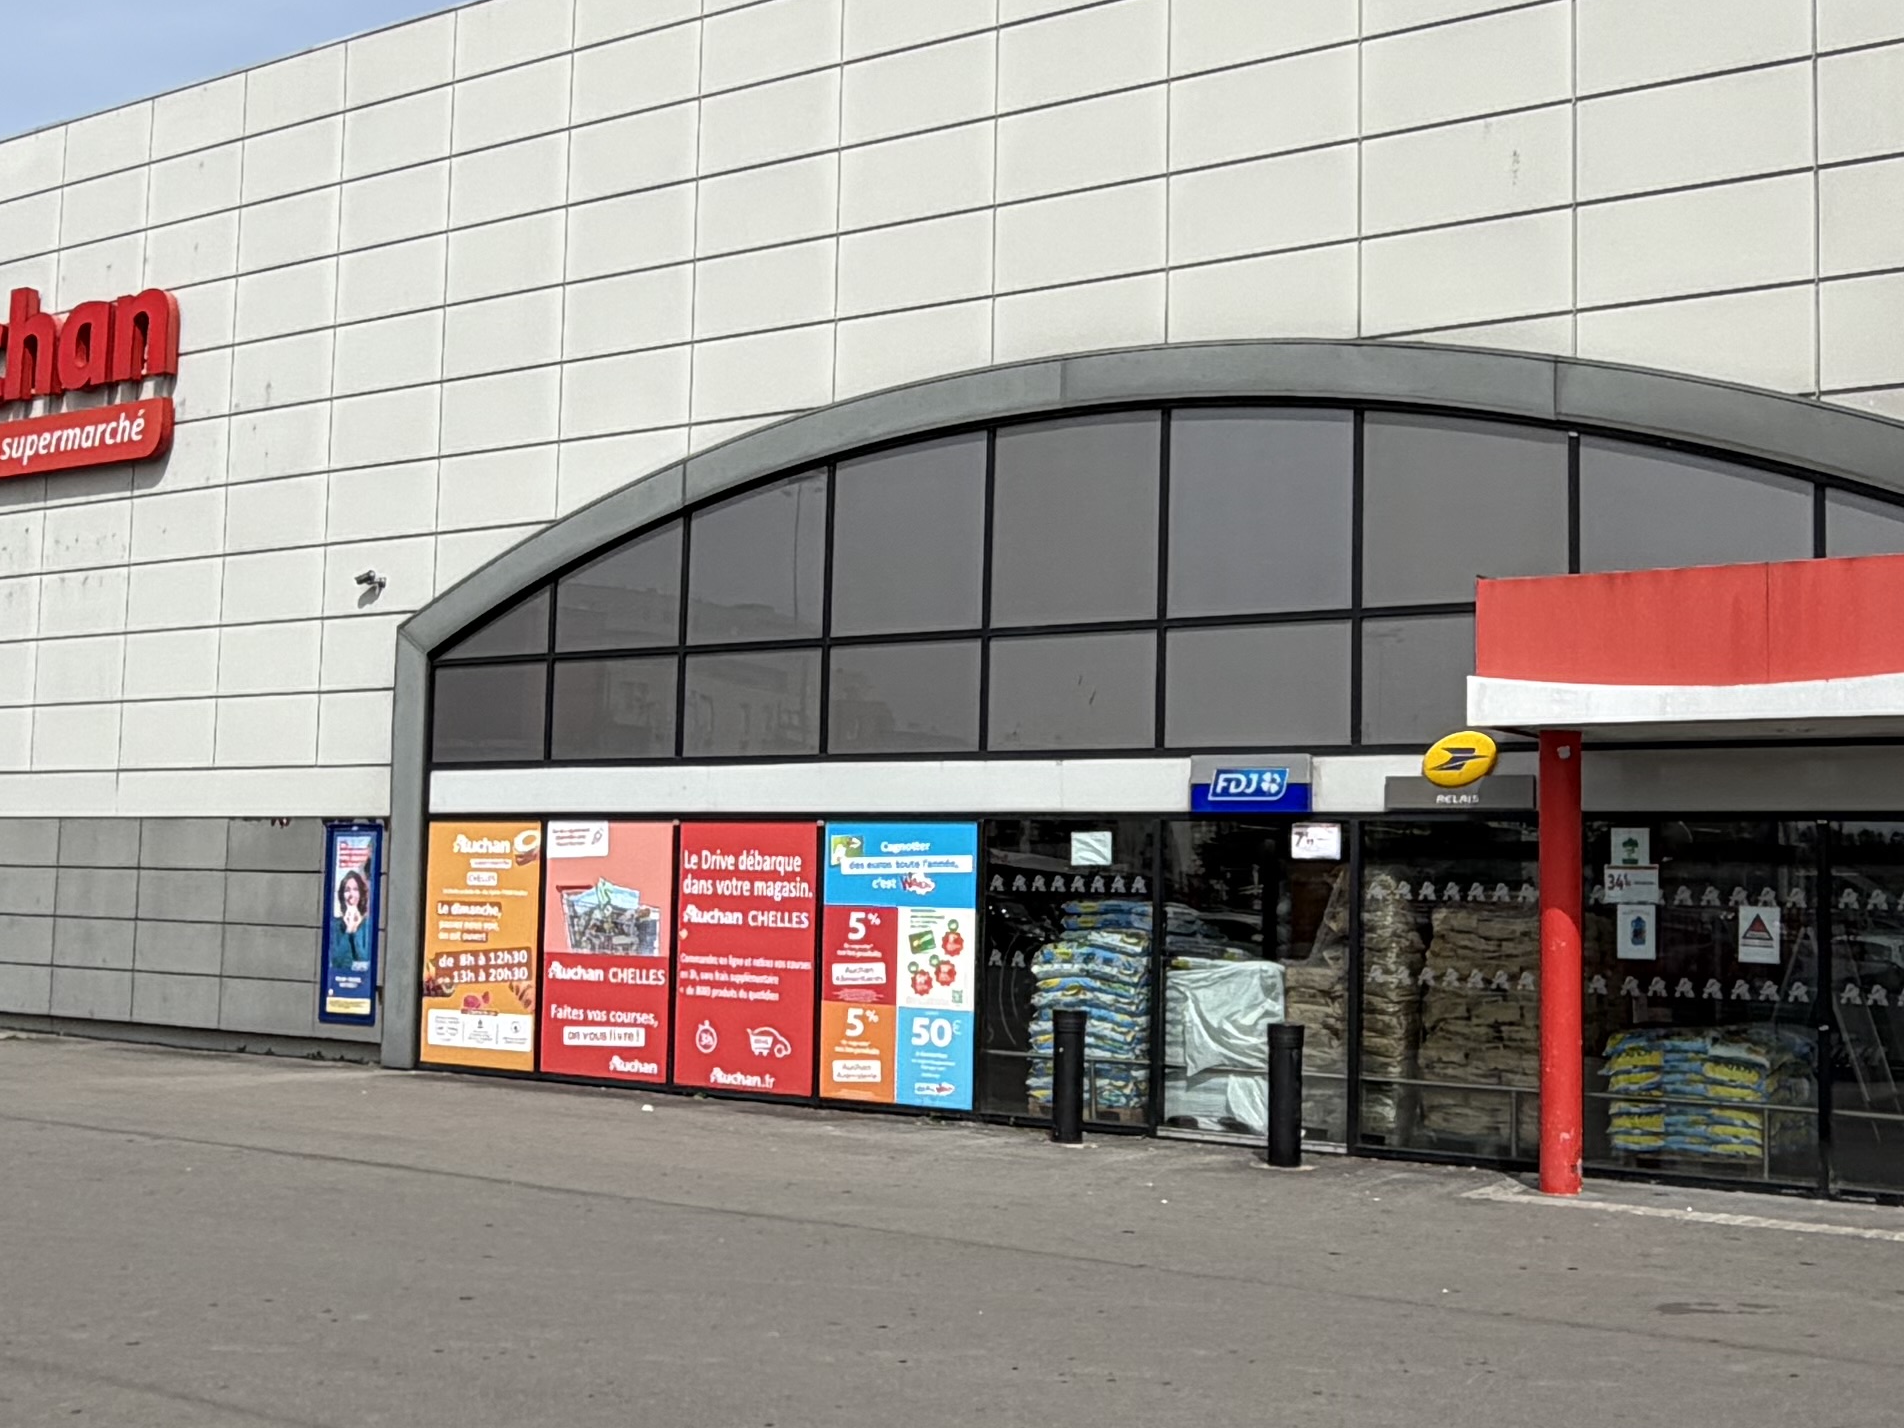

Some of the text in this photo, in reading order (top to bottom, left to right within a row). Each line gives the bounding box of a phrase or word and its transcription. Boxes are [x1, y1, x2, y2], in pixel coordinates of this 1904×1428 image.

[0, 409, 145, 465] supermarché
[1215, 773, 1259, 794] FDJ
[1436, 794, 1480, 804] RELAIS
[453, 834, 511, 853] Auchan
[684, 849, 802, 876] Le Drive débarque
[683, 873, 813, 901] dans votre magasin.
[438, 903, 502, 918] Le dimanche,
[683, 904, 809, 928] Auchan CHELLES
[439, 954, 454, 967] de
[478, 952, 486, 965] à
[489, 950, 528, 965] 12h30
[453, 970, 475, 983] 13h
[478, 969, 486, 982] à
[489, 967, 528, 982] 20h30
[548, 961, 665, 985] Auchan CHELLES
[550, 1004, 658, 1028] Faites vos courses,
[568, 1031, 580, 1040] on
[583, 1031, 607, 1041] vous
[609, 1055, 658, 1074] Auchan
[710, 1067, 775, 1088] Auchan.fr
